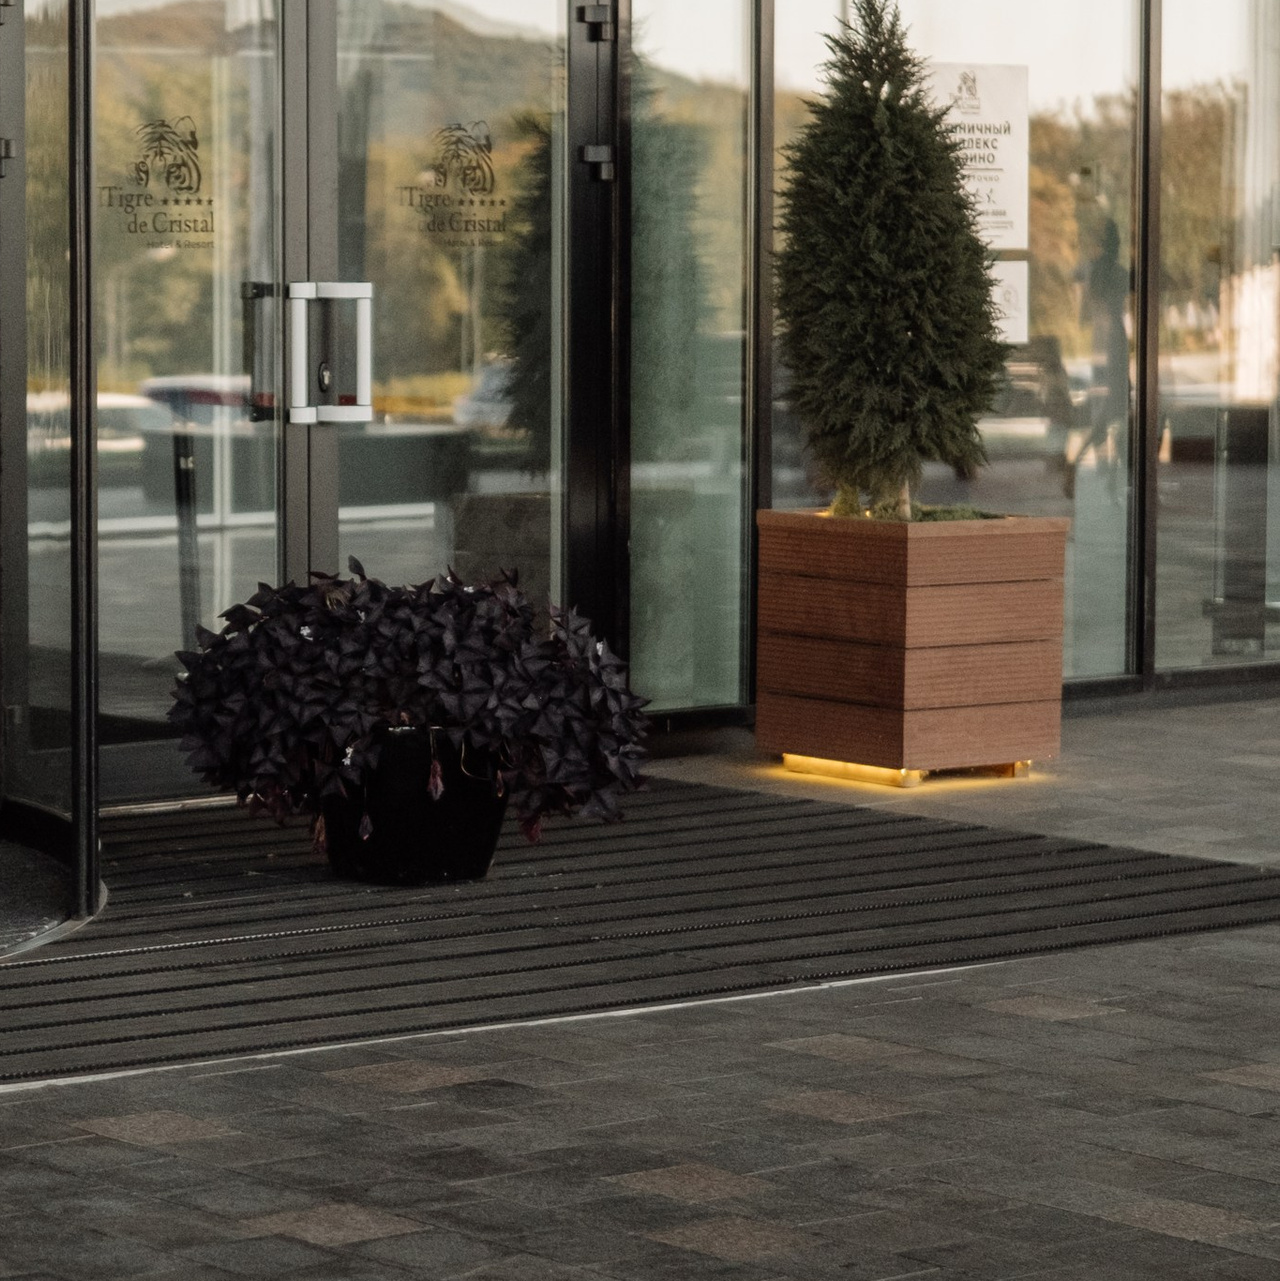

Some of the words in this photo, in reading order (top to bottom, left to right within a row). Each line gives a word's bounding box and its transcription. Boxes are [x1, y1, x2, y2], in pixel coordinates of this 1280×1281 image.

[104, 186, 153, 214] Tigre
[404, 186, 451, 214] Tigre
[127, 213, 148, 234] de
[152, 211, 215, 234] Cristal
[427, 213, 445, 232] de
[449, 211, 507, 233] Cristal
